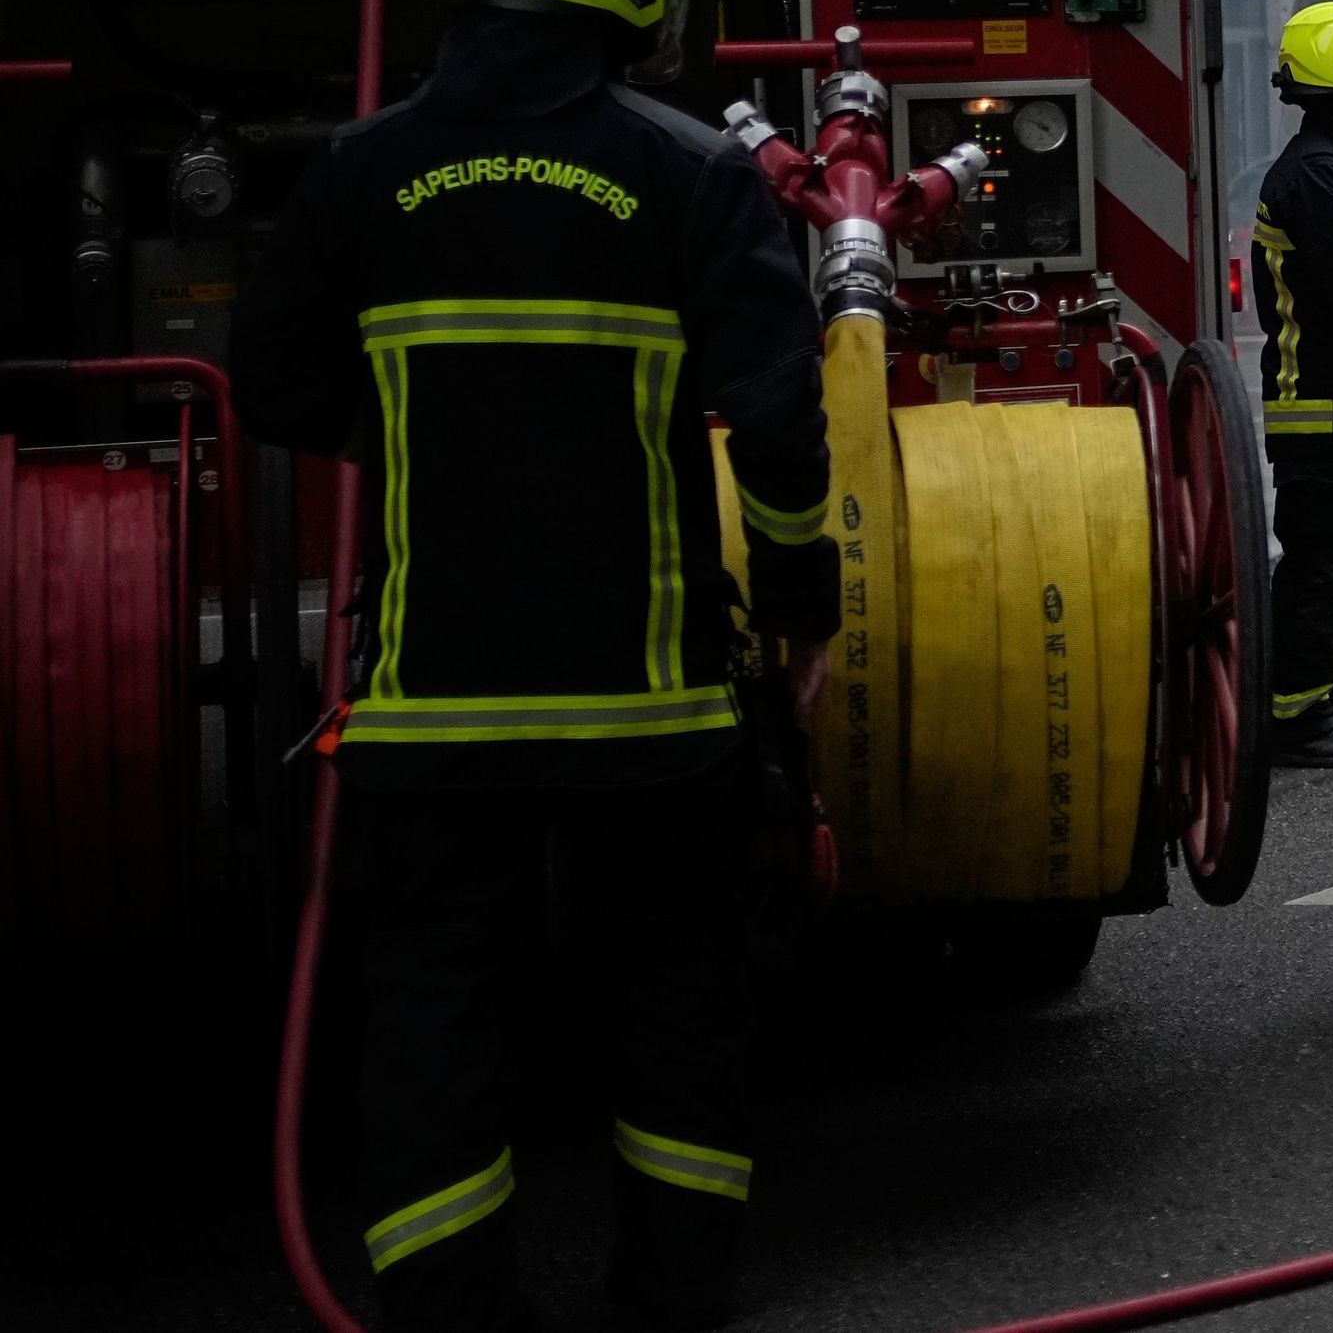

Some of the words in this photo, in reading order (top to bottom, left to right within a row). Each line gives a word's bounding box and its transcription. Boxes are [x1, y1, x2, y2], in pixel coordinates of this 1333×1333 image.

[984, 24, 1024, 33] EMULSEUR
[396, 156, 639, 221] SAPEURS-POMPIERS
[172, 384, 191, 395] 25
[844, 540, 864, 564] NF
[846, 578, 866, 616] 377
[847, 630, 868, 669] 232
[1046, 632, 1066, 658] NF
[1048, 671, 1069, 710] 377
[1049, 723, 1070, 760] 232
